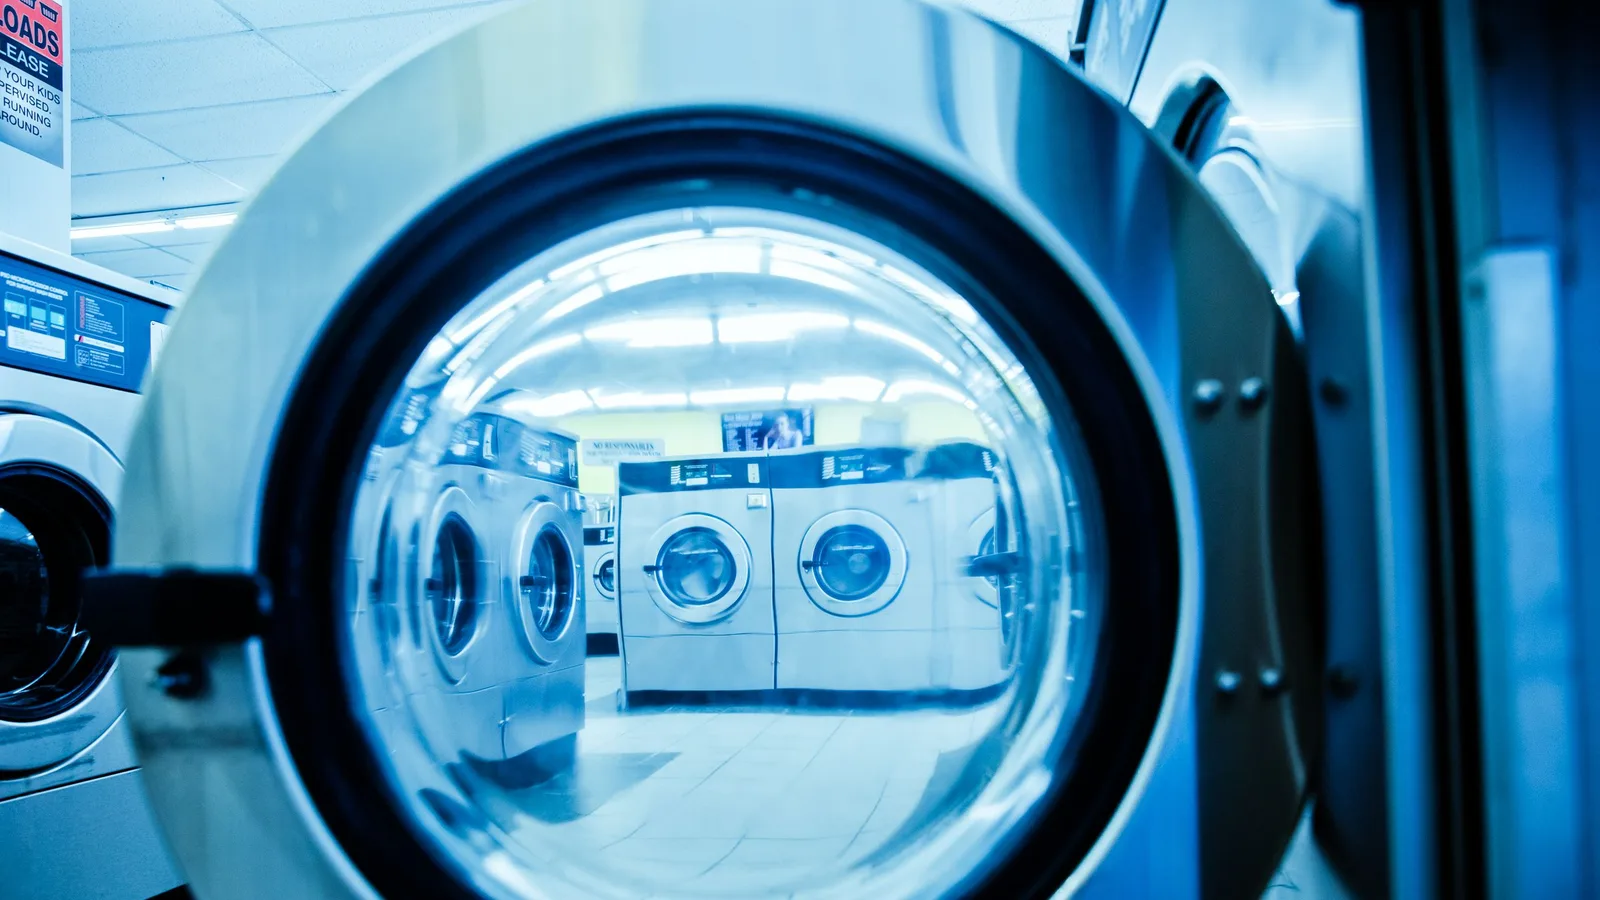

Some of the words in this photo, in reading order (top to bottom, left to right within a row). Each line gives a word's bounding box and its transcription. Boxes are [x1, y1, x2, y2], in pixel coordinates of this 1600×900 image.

[0, 4, 59, 57] OADS
[4, 67, 35, 91] YOUR
[37, 85, 60, 105] KIDS
[0, 110, 42, 138] ROUND.
[4, 96, 51, 128] RUNNING
